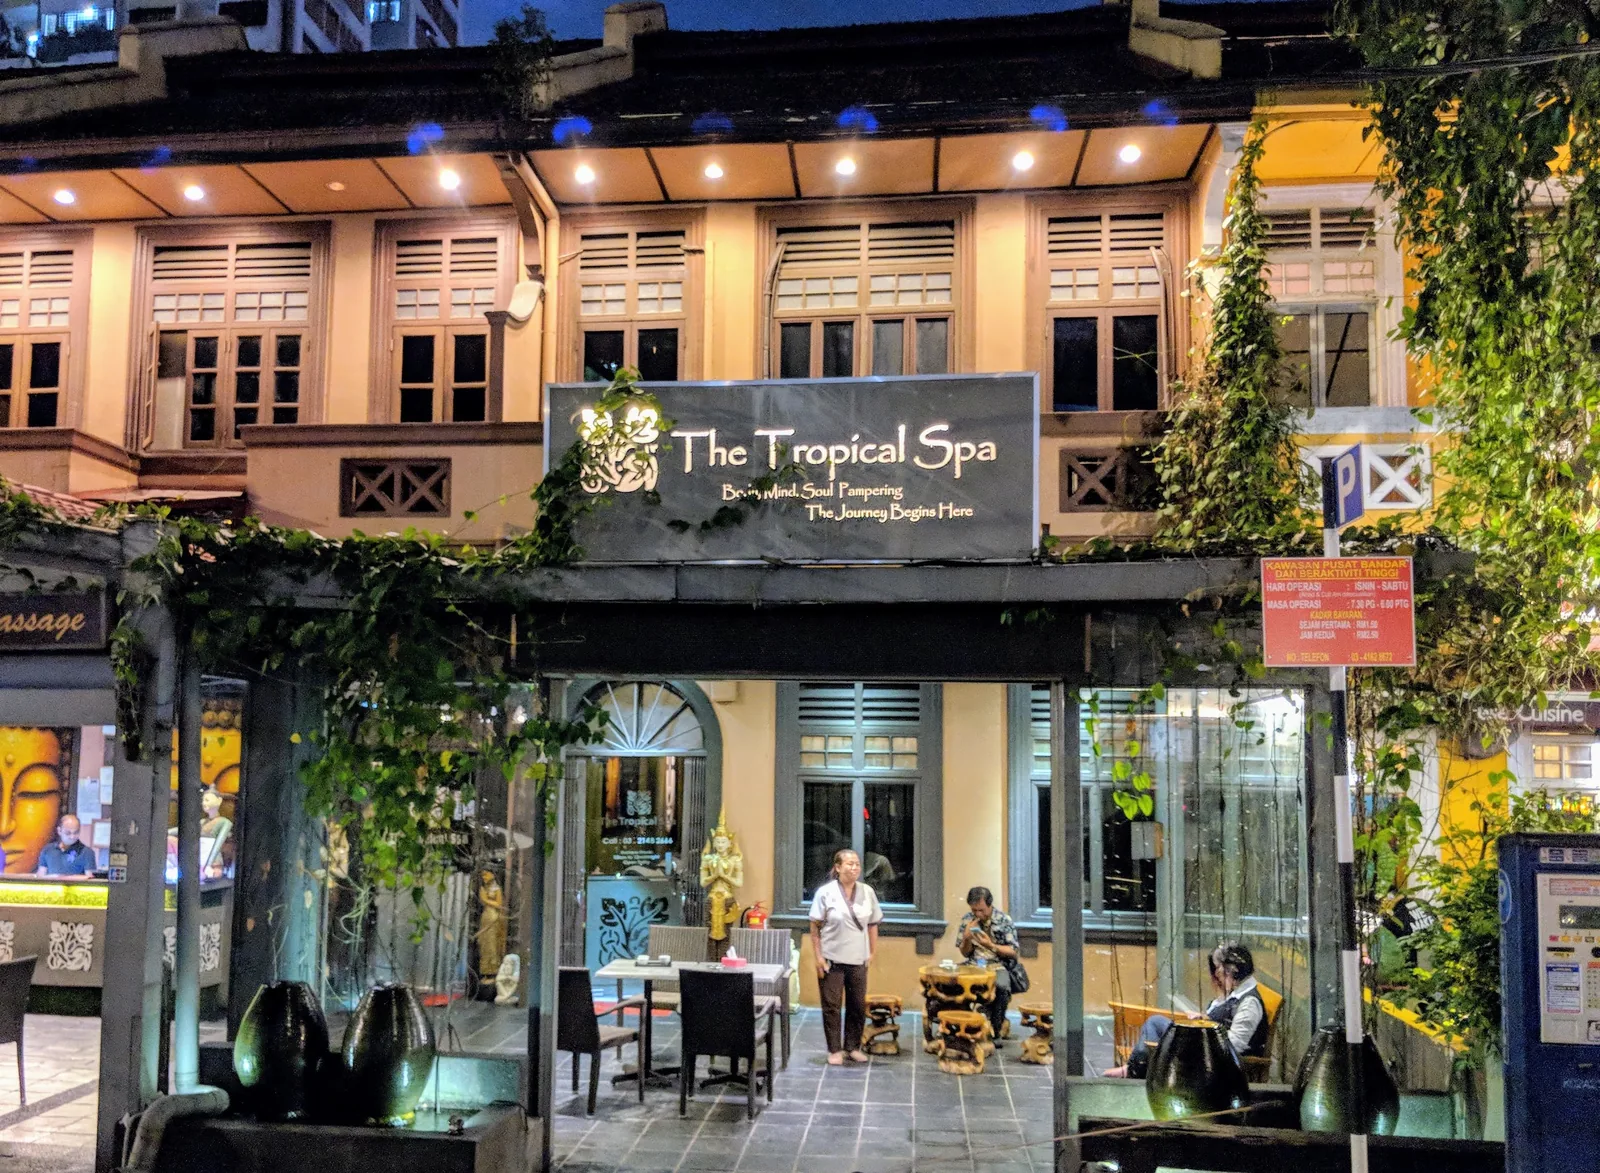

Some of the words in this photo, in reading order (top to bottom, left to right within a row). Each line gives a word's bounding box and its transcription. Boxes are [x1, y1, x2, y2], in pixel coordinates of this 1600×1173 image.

[670, 427, 748, 474] The
[754, 423, 906, 482] Tropical
[913, 423, 997, 479] Spa
[800, 481, 834, 500] Soul
[838, 481, 904, 502] Pampering
[1336, 453, 1356, 524] P
[805, 503, 834, 521] The
[834, 503, 888, 523] Journey
[889, 503, 937, 523] Begins
[938, 502, 974, 519] Here
[1266, 560, 1320, 570] KAWASAN
[1322, 560, 1358, 569] PUSAT
[1361, 559, 1407, 568] BANDAR
[1275, 570, 1297, 578] DAN
[1299, 569, 1362, 578] BERAKTIVITI
[1365, 569, 1399, 578] TINGGI
[1266, 582, 1286, 592] HARI
[1286, 582, 1322, 591] OPERASI
[1354, 581, 1376, 591] ISNIN
[1381, 581, 1409, 591] SABTU
[1266, 600, 1289, 609] MASA
[1289, 600, 1321, 609] OPERASI
[1365, 600, 1376, 608] PG
[1395, 600, 1409, 608] PTG
